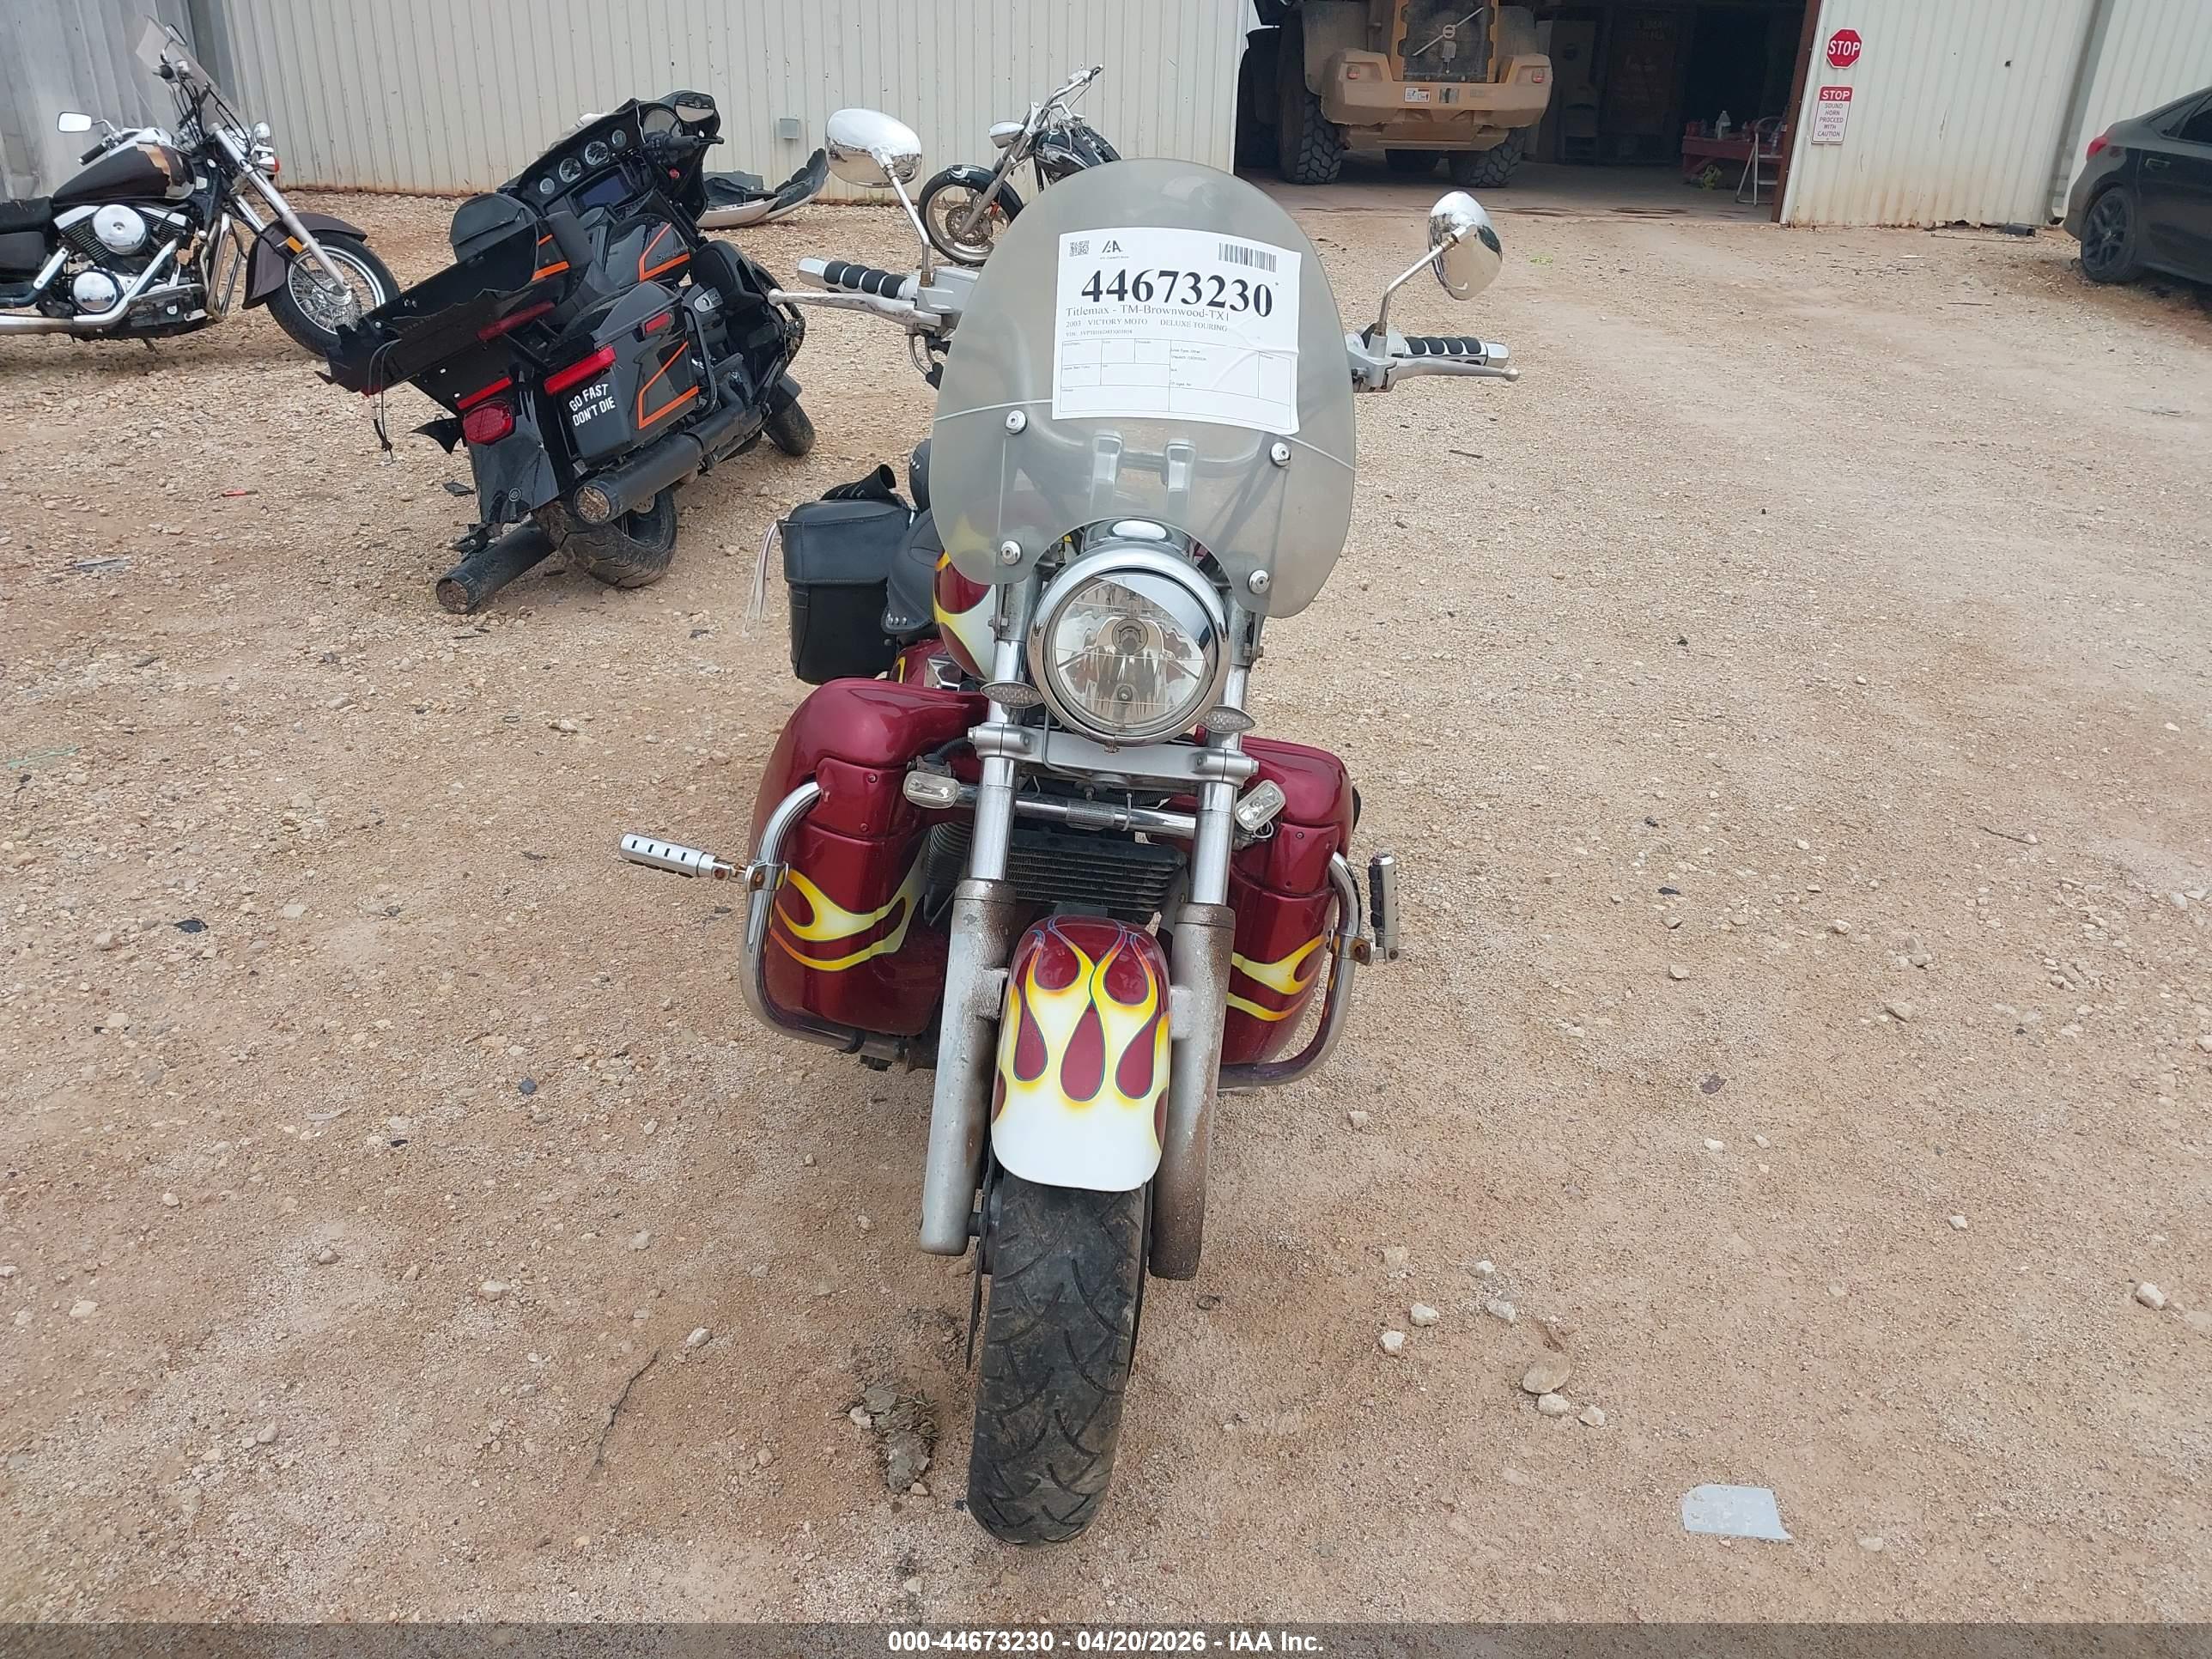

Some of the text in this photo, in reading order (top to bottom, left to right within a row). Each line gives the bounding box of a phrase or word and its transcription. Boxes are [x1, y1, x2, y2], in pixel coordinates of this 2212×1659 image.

[1828, 40, 1860, 56] STOP
[1821, 90, 1850, 100] STOP
[1081, 269, 1273, 317] 44673230
[1066, 307, 1109, 317] Titlemax
[1160, 319, 1191, 328] DELUXE
[1194, 321, 1228, 332] TOURING
[569, 384, 609, 411] GO FAST
[572, 396, 616, 427] DON'T DIE
